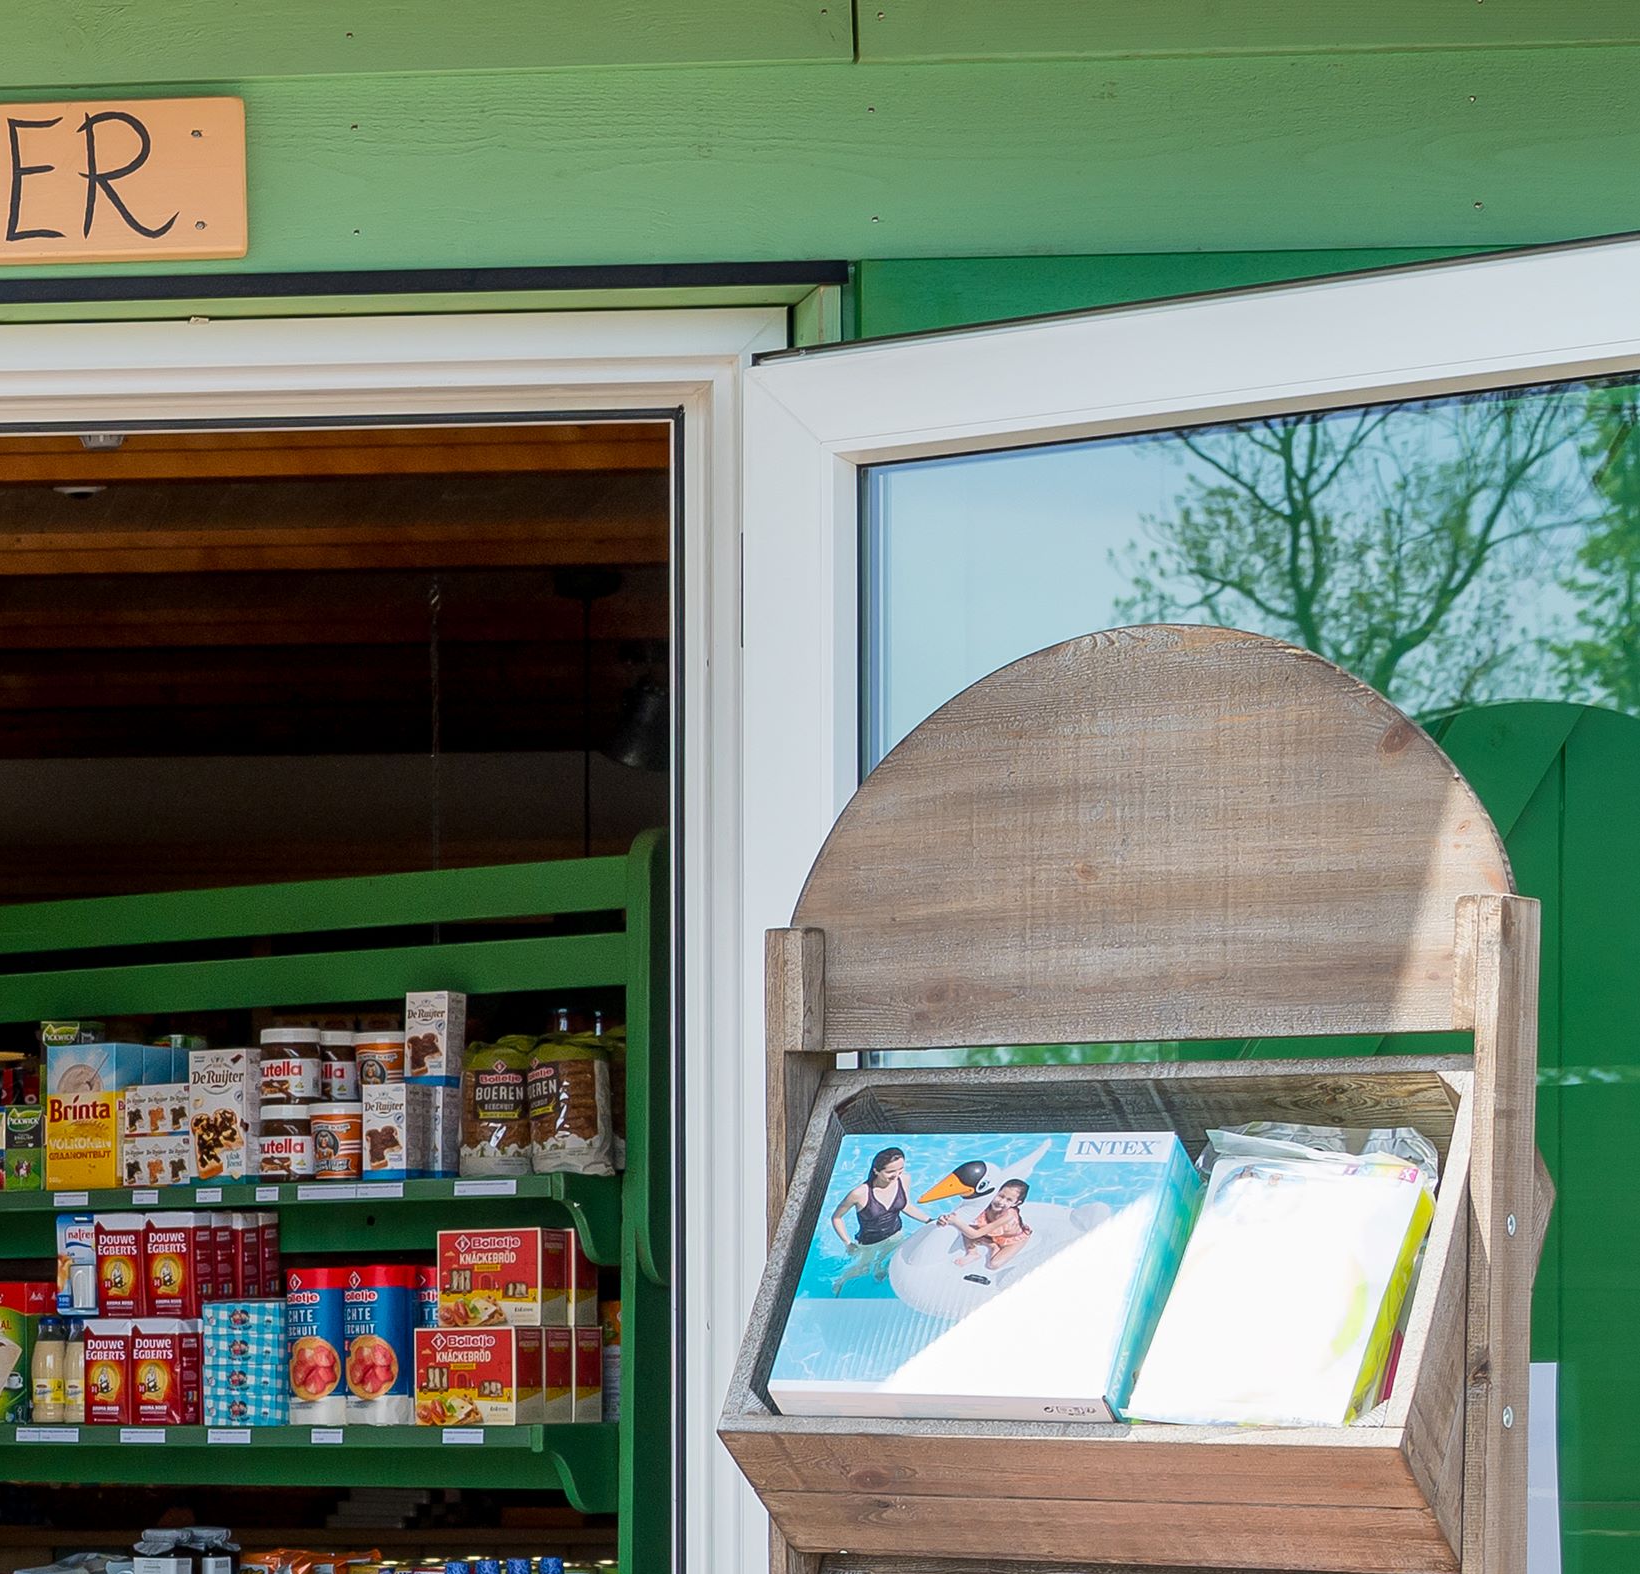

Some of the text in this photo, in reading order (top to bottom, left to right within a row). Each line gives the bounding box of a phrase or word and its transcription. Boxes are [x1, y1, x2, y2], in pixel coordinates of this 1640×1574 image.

[192, 1070, 244, 1088] De Ruijter
[476, 1086, 524, 1101] BOEREN
[49, 1094, 111, 1122] Brinta
[49, 1149, 111, 1161] GRAANONTBIJT
[1074, 1140, 1157, 1156] INTEX
[98, 1244, 137, 1256] EGBERTS
[147, 1242, 186, 1254] EGBERTS
[471, 1235, 521, 1251] Bolletje
[447, 1333, 495, 1349] Bolletje
[85, 1349, 126, 1361] EGBERTS
[133, 1348, 173, 1360] EGBERTS
